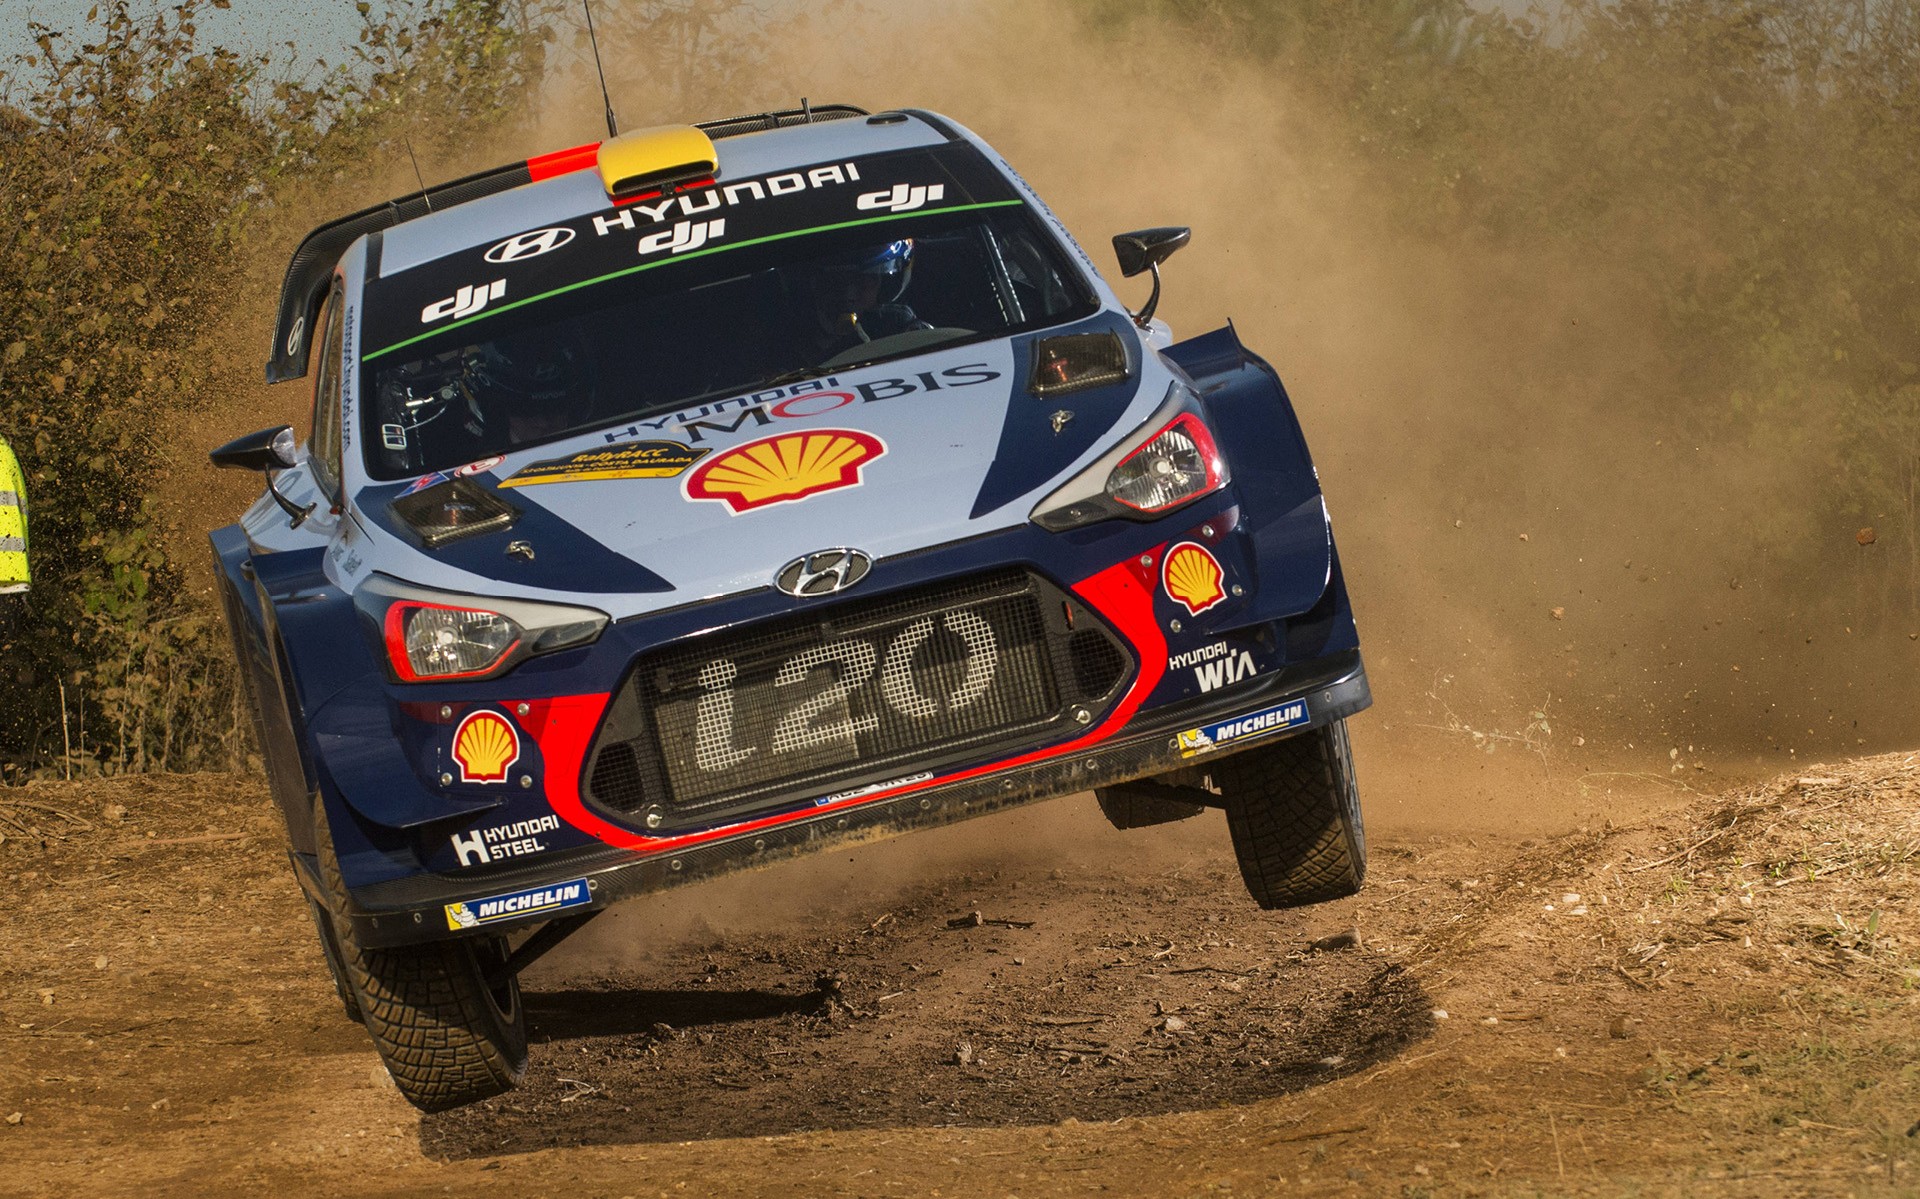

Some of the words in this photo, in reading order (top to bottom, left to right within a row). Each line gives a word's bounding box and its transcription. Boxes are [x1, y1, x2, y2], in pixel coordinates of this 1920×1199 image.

[592, 162, 861, 236] HYUNDAI
[856, 184, 944, 212] dji
[638, 218, 726, 254] dji
[421, 278, 507, 323] dji
[604, 377, 840, 443] HYUNDAI
[680, 363, 1001, 443] MOBIS
[1169, 641, 1228, 670] HYUNDAI
[1194, 648, 1257, 693] WIA
[1216, 704, 1302, 741] MICHELIN
[483, 814, 560, 844] HYUNDAI
[490, 837, 545, 859] STEEL
[479, 884, 580, 917] MICHELIN
